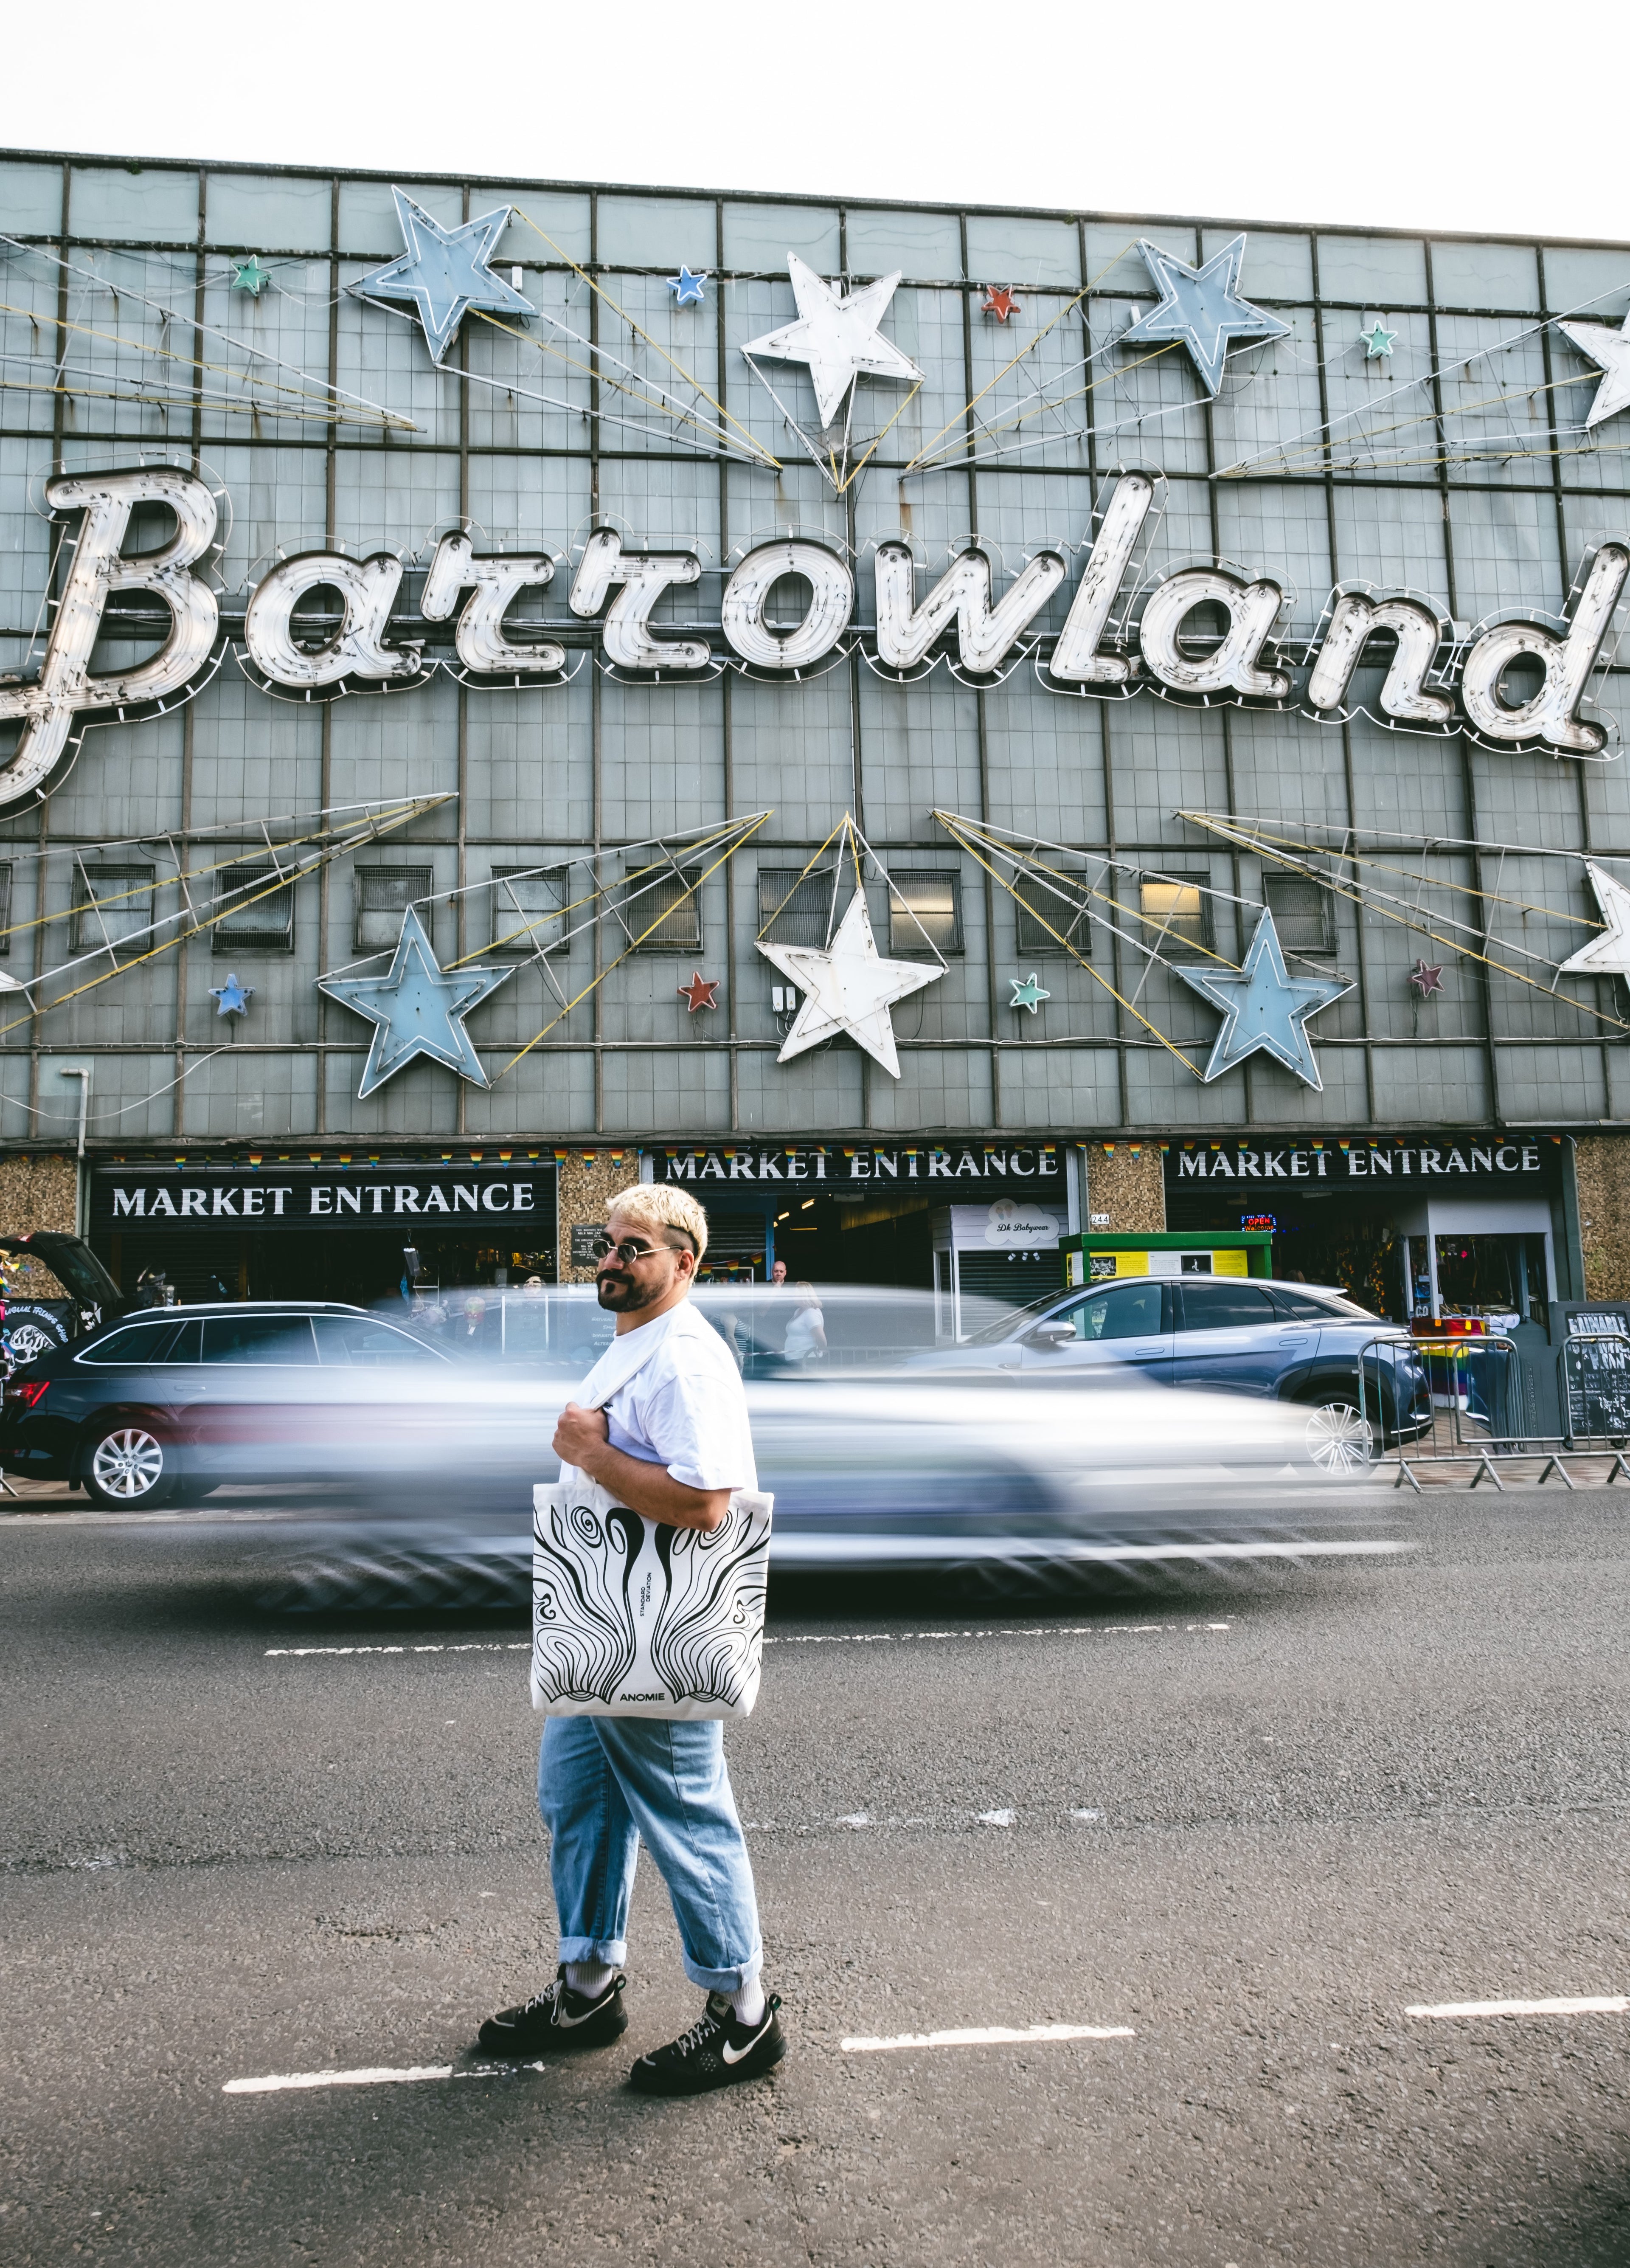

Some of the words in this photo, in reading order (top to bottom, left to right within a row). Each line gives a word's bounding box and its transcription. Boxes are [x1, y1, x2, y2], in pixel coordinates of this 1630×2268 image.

[0, 464, 1630, 803] Barrowland
[666, 1152, 833, 1179] MARKET
[849, 1150, 1058, 1179] ENTRANCE
[1178, 1151, 1332, 1177] MARKET
[1349, 1146, 1541, 1175] ENTRANCE
[112, 1188, 292, 1216] MARKET
[309, 1183, 535, 1214] ENTRANCE
[997, 1223, 1011, 1232] Dk
[1013, 1223, 1050, 1233] Babywear
[620, 1693, 665, 1702] ANOMIE
